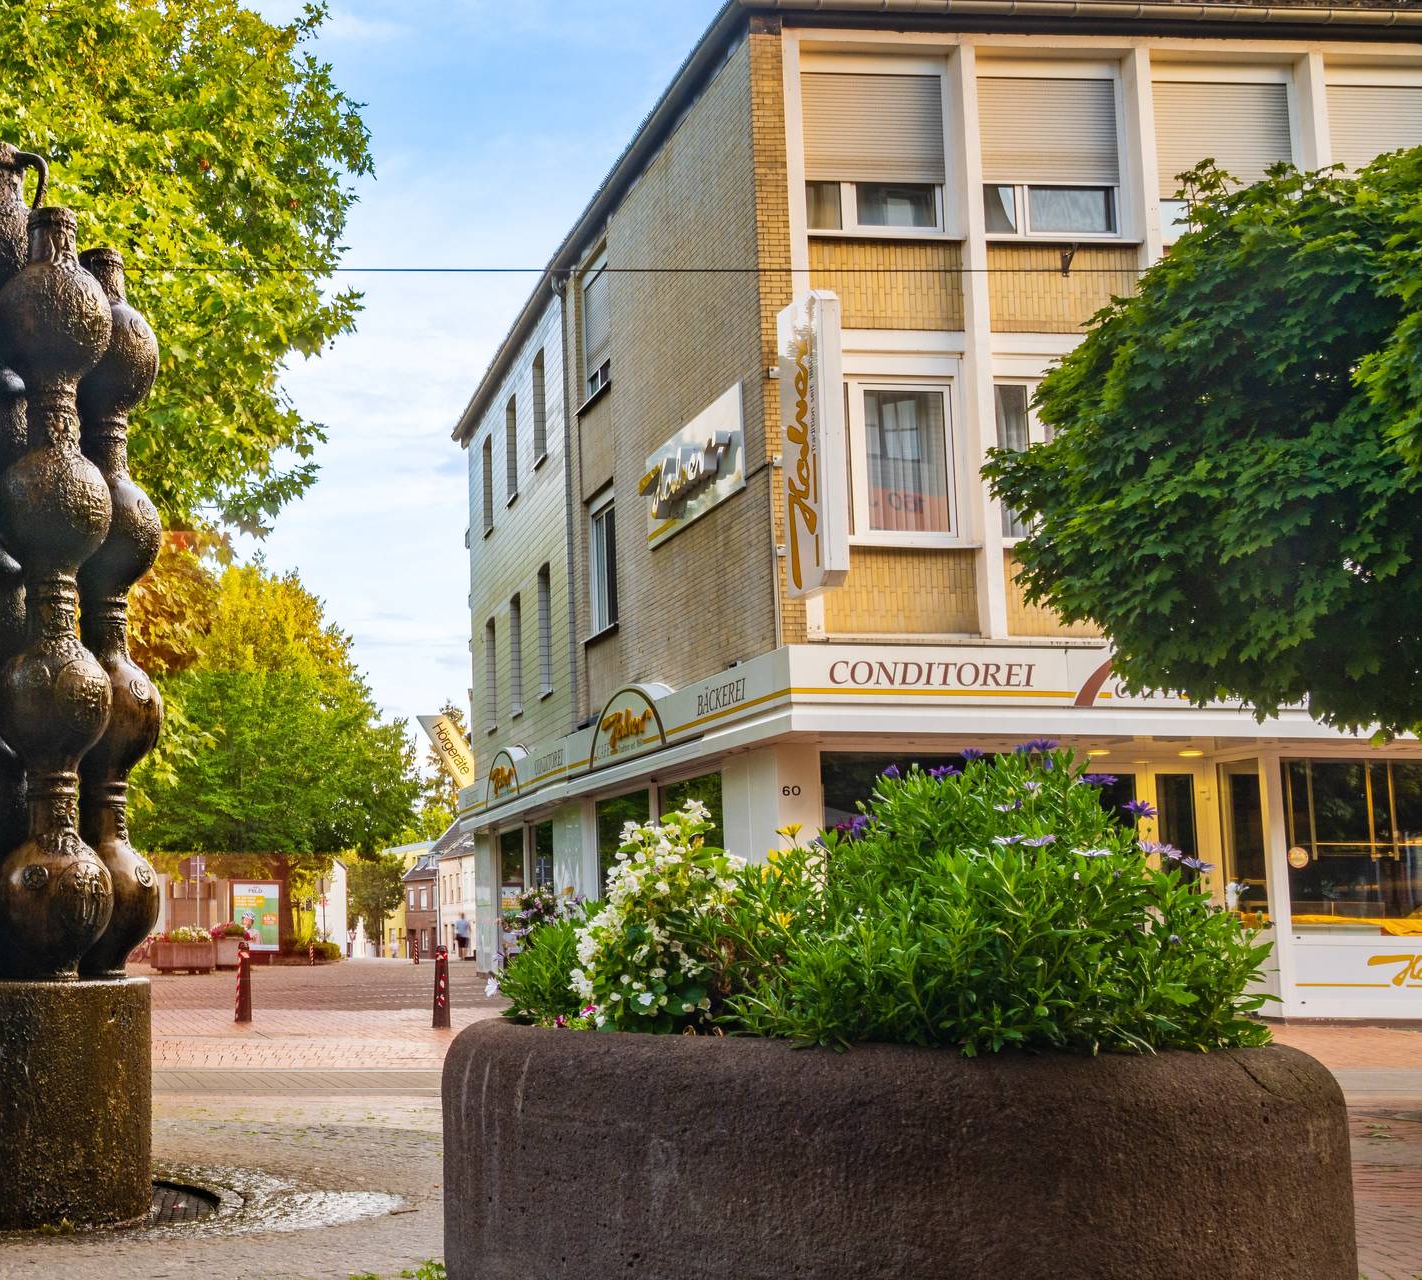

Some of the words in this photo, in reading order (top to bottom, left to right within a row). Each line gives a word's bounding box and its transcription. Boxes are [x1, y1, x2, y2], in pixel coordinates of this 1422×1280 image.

[829, 660, 1036, 688] CONDITOREI
[696, 677, 747, 717] BÄCKEREI
[432, 721, 470, 775] Hörgeräte
[781, 784, 802, 797] 60
